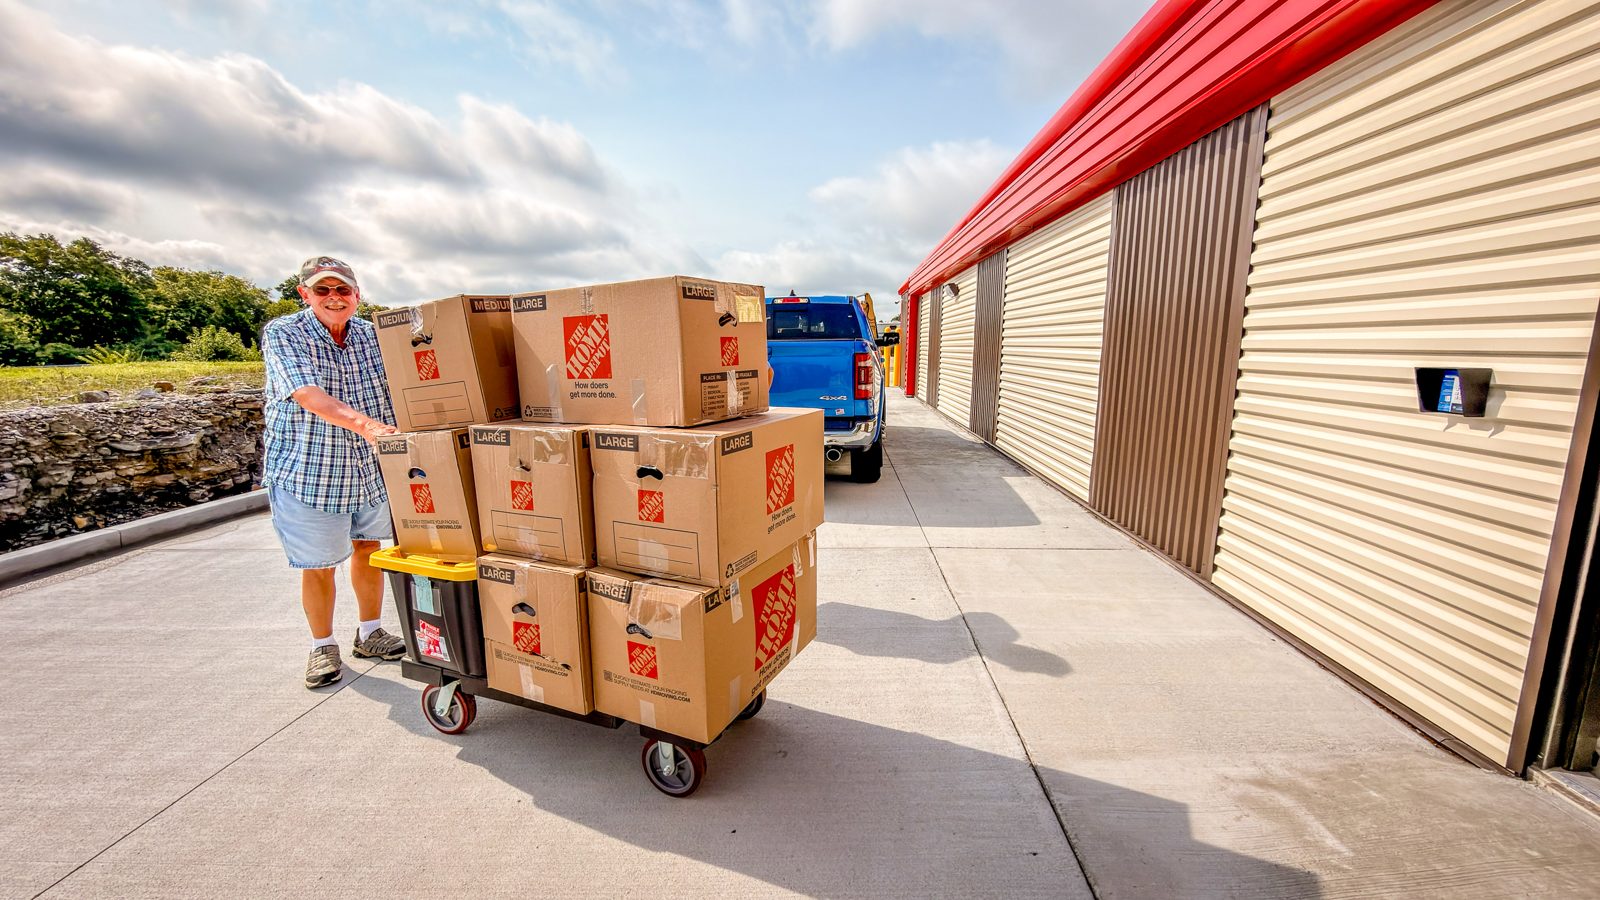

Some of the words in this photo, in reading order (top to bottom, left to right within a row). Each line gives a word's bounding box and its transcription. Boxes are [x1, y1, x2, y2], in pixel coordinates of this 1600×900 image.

[685, 285, 715, 298] LARGE
[516, 297, 544, 310] LARGE
[568, 322, 587, 349] THE
[566, 313, 609, 379] HOME
[583, 337, 611, 379] DEPOT
[569, 391, 580, 399] get
[598, 391, 617, 399] done.
[574, 381, 589, 389] How
[589, 381, 609, 389] doers
[381, 441, 406, 452] LARGE
[477, 431, 507, 443] LARGE
[599, 435, 634, 449] LARGE
[724, 434, 751, 452] LARGE
[769, 455, 781, 481] THE
[766, 445, 795, 512] HOME
[778, 464, 795, 508] DEPOT
[512, 481, 533, 509] HOME
[513, 484, 522, 495] THE
[640, 493, 651, 506] THE
[639, 489, 664, 521] HOME
[648, 503, 664, 522] DEPOT
[771, 511, 781, 522] How
[781, 506, 793, 518] doers
[767, 524, 775, 535] get
[775, 518, 786, 529] more
[482, 567, 512, 582] LARGE
[592, 579, 627, 600] LARGE
[708, 583, 737, 607] LAGE
[759, 586, 777, 624] THE
[755, 567, 795, 664] HOME
[772, 592, 797, 654] DEPOT
[515, 623, 540, 652] HOME
[516, 625, 526, 638] THE
[629, 645, 657, 674] HOME
[630, 646, 643, 659] THE
[758, 660, 773, 678] How
[773, 646, 789, 666] doers
[640, 658, 657, 676] DEPOT
[751, 678, 763, 697] get
[763, 666, 777, 685] more
